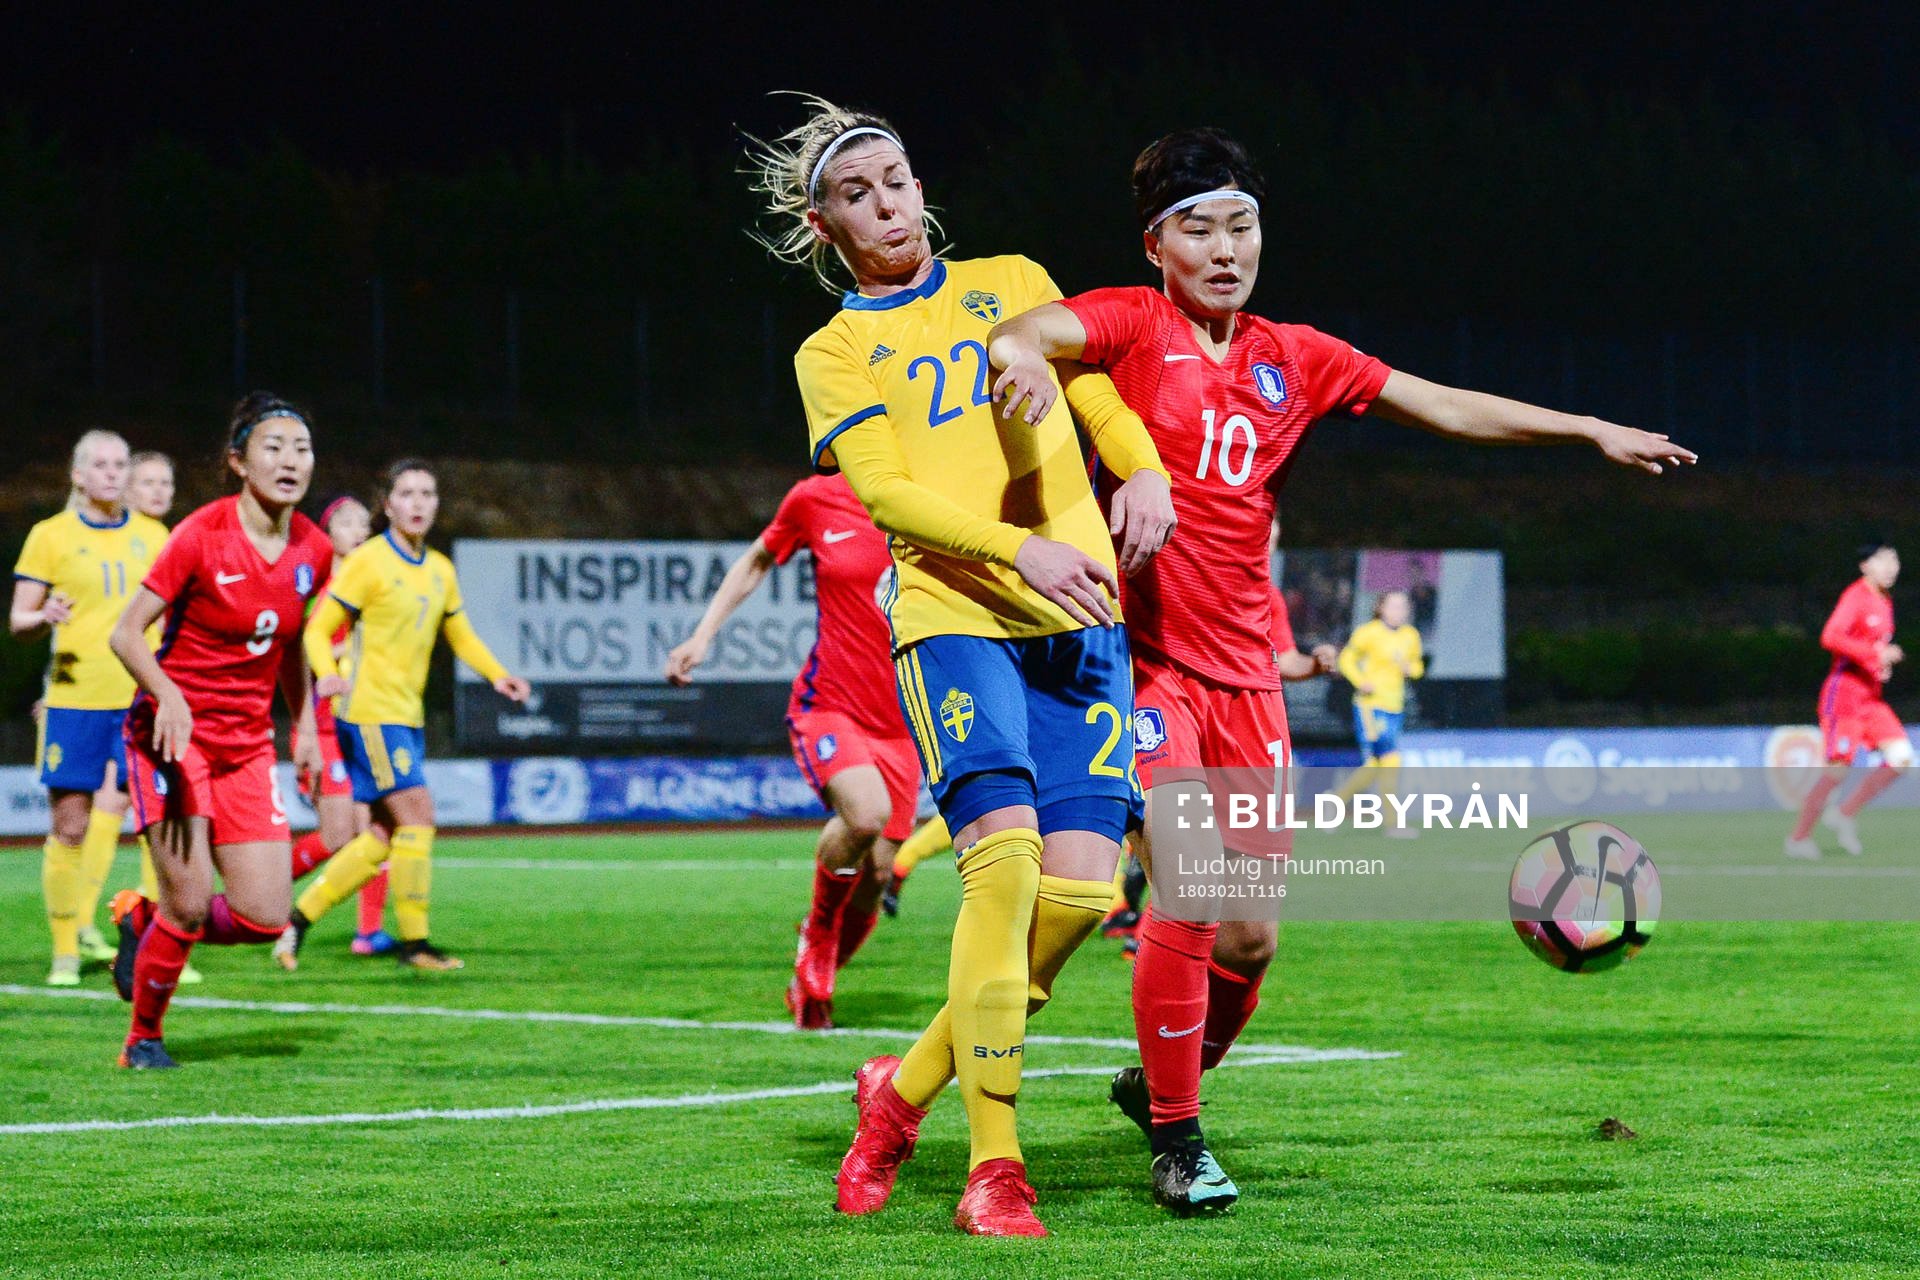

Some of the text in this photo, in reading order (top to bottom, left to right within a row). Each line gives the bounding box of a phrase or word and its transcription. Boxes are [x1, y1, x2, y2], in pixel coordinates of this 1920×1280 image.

[868, 349, 897, 367] adidas
[907, 340, 1007, 428] 22
[1195, 409, 1258, 487] 10
[101, 562, 126, 598] 11
[415, 595, 429, 629] 7
[518, 617, 630, 671] NOS
